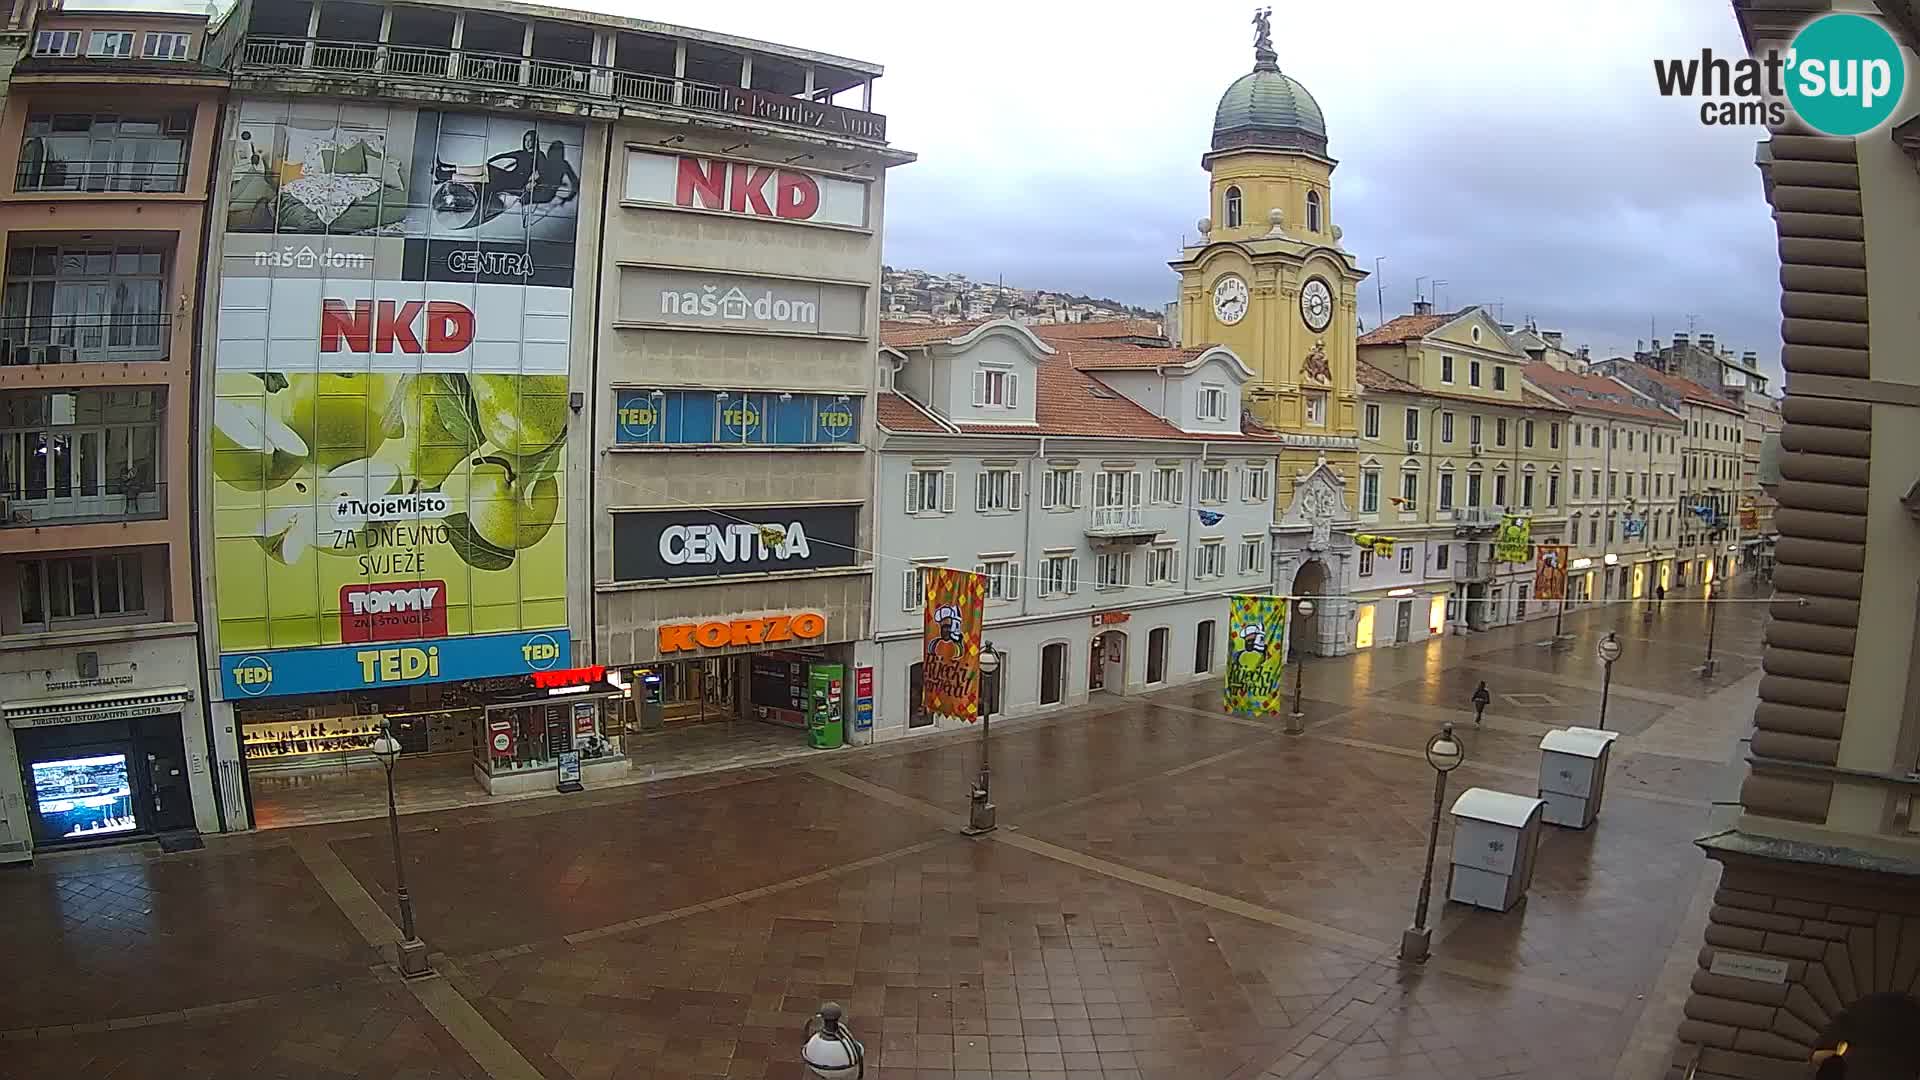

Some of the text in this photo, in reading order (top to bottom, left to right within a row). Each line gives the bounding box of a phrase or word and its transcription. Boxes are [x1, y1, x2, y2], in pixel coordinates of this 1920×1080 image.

[675, 157, 822, 220] NKD
[447, 250, 535, 276] CENTRA
[661, 284, 816, 324] naš dom
[320, 298, 477, 354] NKD
[618, 409, 657, 426] TEDi
[723, 409, 760, 427] TEDi
[819, 412, 853, 428] TEDi
[337, 497, 446, 517] #TvojeMisto
[333, 524, 450, 550] ZA DNEVNO
[659, 521, 811, 565] CENTRA
[358, 548, 426, 576] SVJEŽE
[348, 587, 439, 615] TOMMY
[657, 612, 825, 654] KORZO
[357, 646, 439, 683] TEDi
[521, 642, 560, 661] TEDi
[232, 666, 273, 685] TEDi
